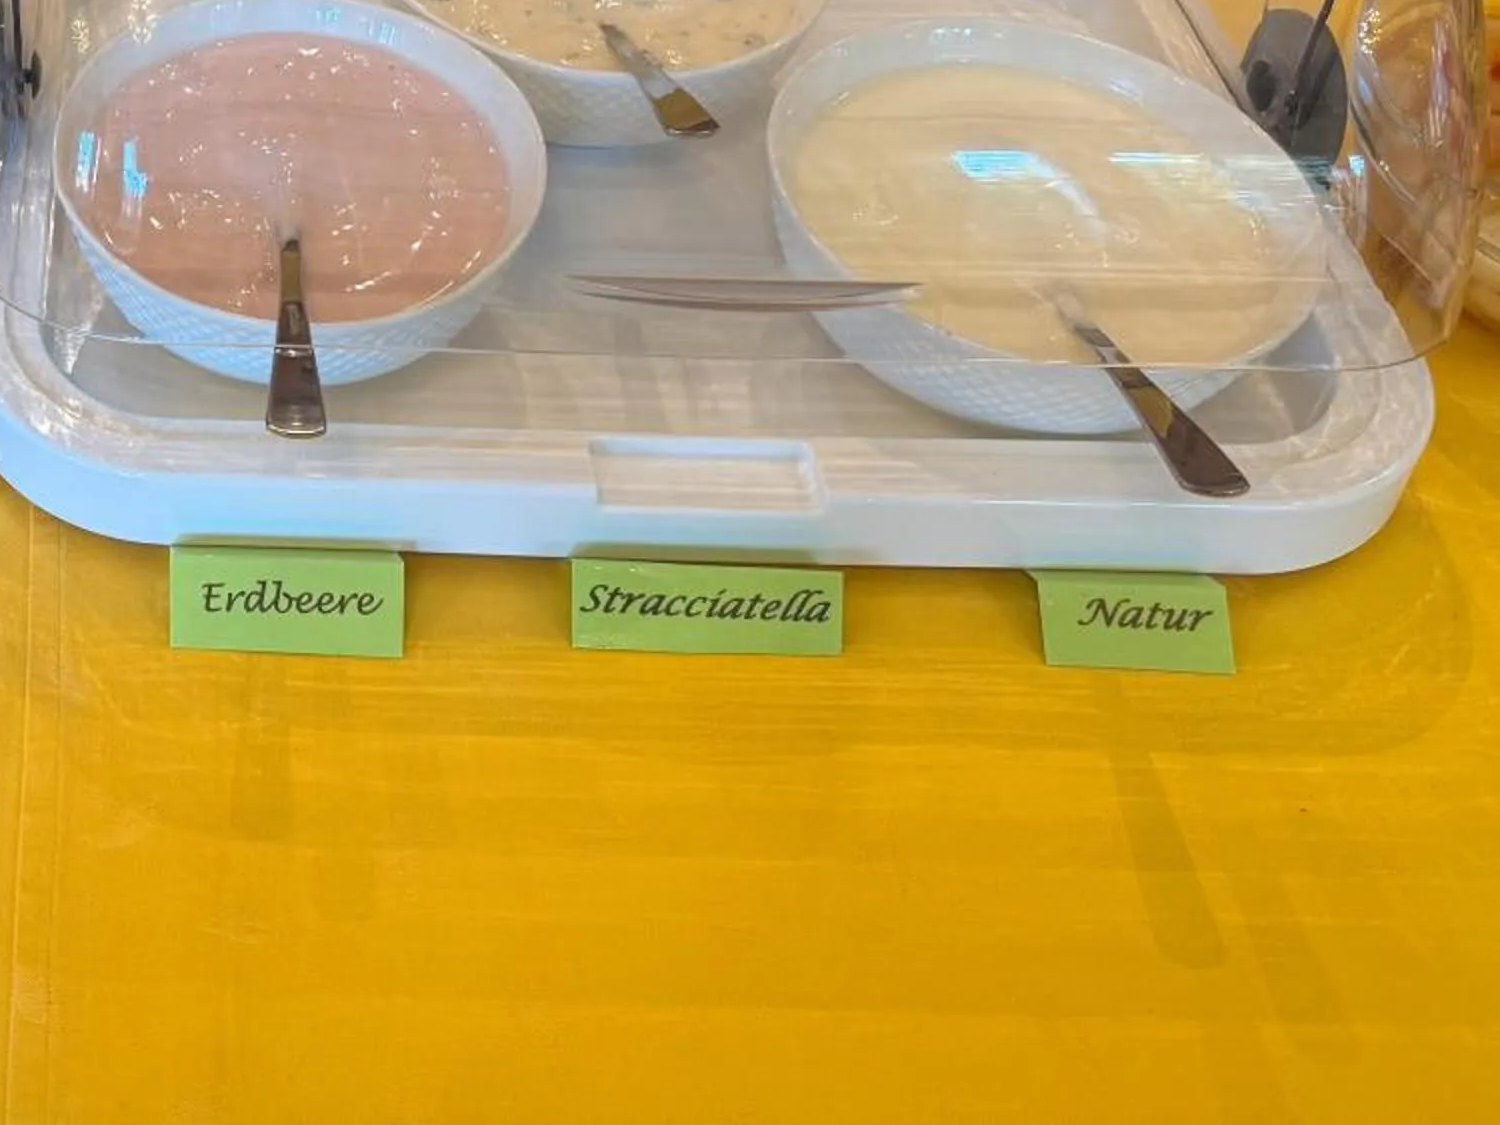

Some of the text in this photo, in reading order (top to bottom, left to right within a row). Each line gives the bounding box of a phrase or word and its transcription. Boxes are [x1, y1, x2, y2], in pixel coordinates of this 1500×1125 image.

[201, 580, 385, 617] Erdbeere
[579, 583, 832, 624] Stracciatella
[1077, 597, 1213, 632] Natur
